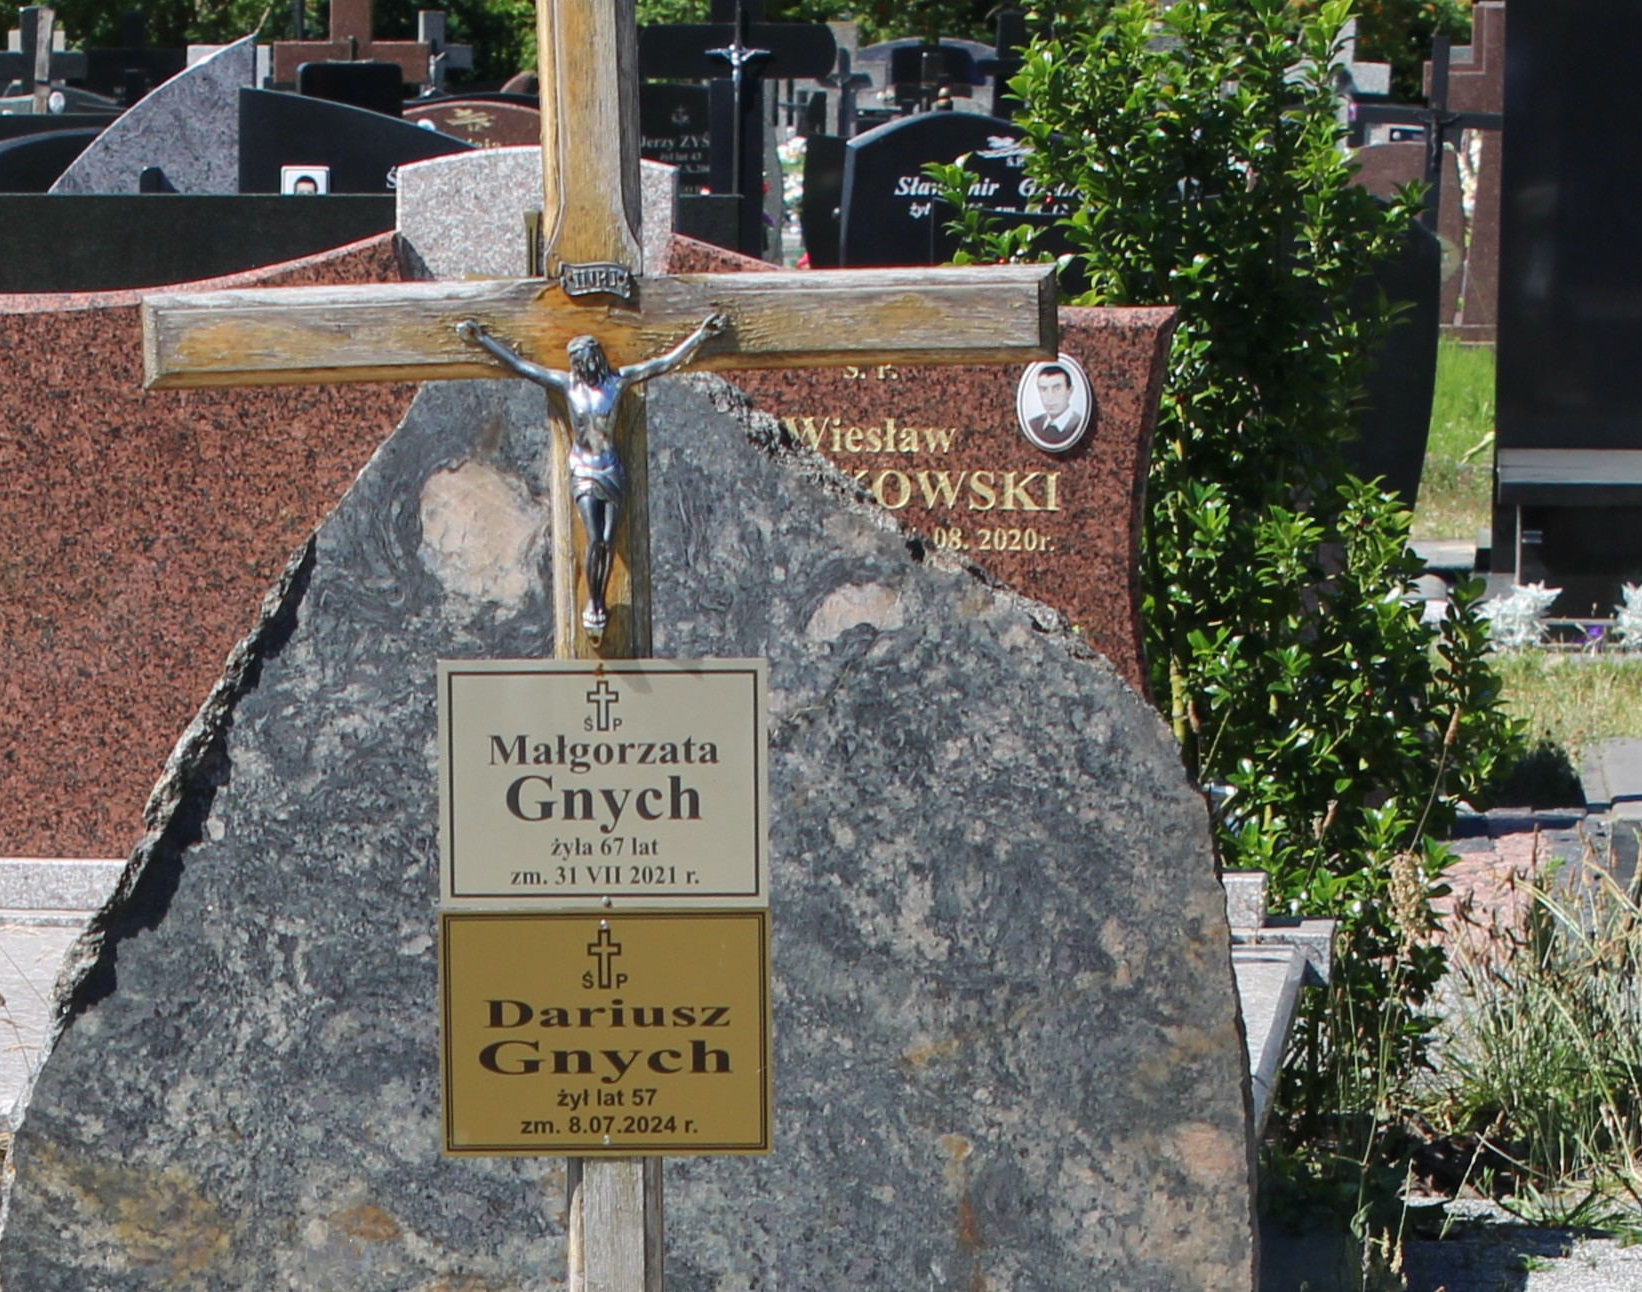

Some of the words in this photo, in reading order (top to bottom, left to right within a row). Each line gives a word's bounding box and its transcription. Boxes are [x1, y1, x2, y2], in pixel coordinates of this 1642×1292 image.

[781, 416, 956, 453] Wiesław
[842, 469, 1061, 511] OWSKI
[977, 527, 1056, 551] 2020r.
[488, 734, 719, 774] Małgorzata
[506, 775, 702, 834] Gnych
[551, 837, 593, 861] żyła
[600, 837, 624, 856] 67
[631, 837, 659, 856] lat
[510, 870, 548, 885] zm.
[554, 865, 577, 885] 31
[586, 865, 621, 885] VII
[629, 865, 677, 885] 2021
[685, 870, 700, 884] r.
[483, 999, 730, 1028] Dariusz
[478, 1040, 733, 1084] Gnych
[557, 1088, 589, 1111] żył
[597, 1088, 624, 1106] lat
[631, 1088, 657, 1106] 57
[520, 1119, 561, 1134] zm.
[568, 1115, 677, 1134] 8.07.2024
[684, 1119, 698, 1134] r.
